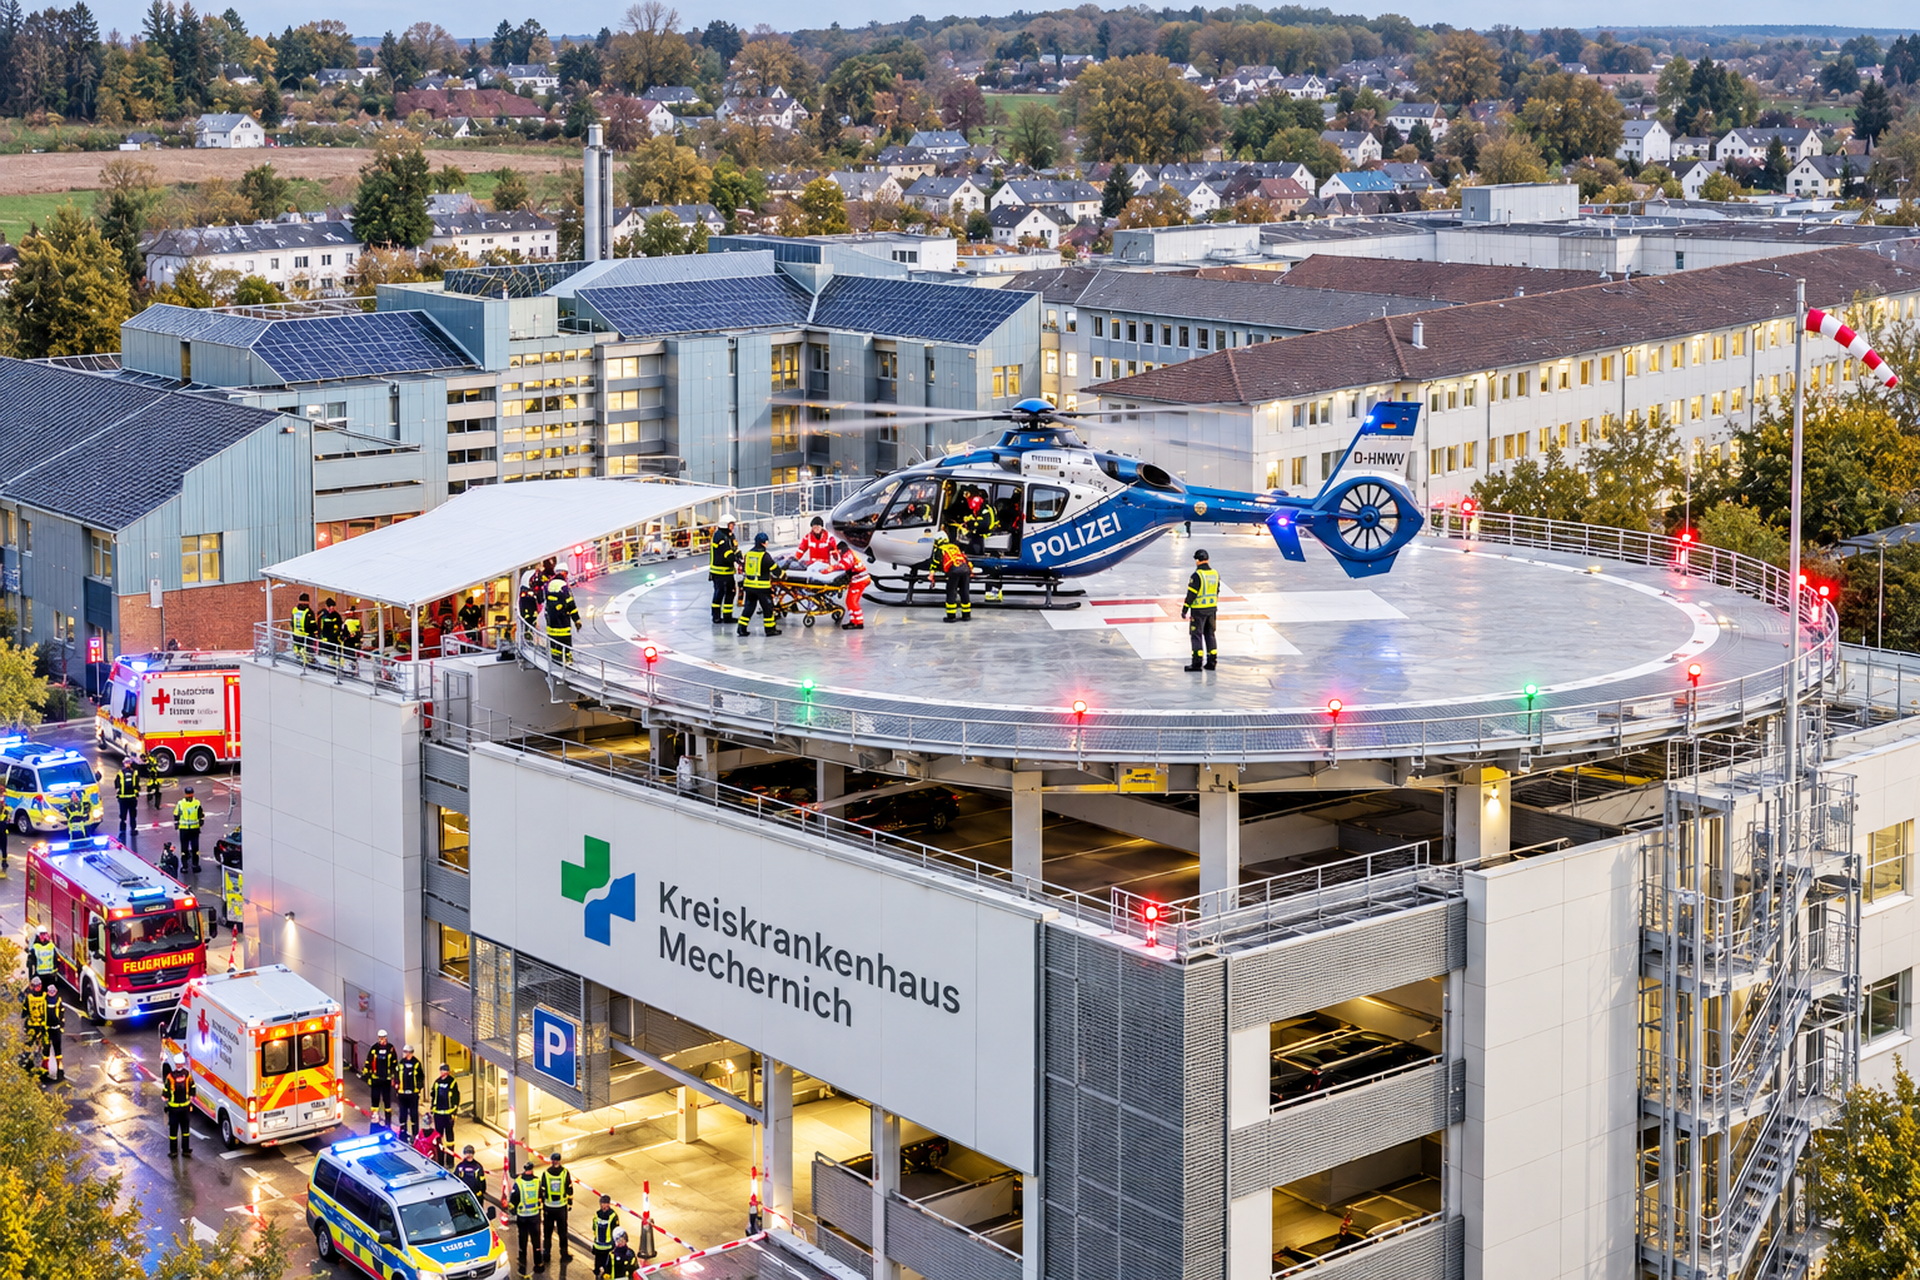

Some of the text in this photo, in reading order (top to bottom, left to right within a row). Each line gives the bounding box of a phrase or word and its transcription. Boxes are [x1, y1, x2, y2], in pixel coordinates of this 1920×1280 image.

[1354, 452, 1405, 465] D-HNWV
[1031, 512, 1122, 563] POLIZEI
[659, 881, 960, 1014] Kreiskrankenhaus
[659, 925, 852, 1027] Mechernich
[543, 1021, 567, 1068] P
